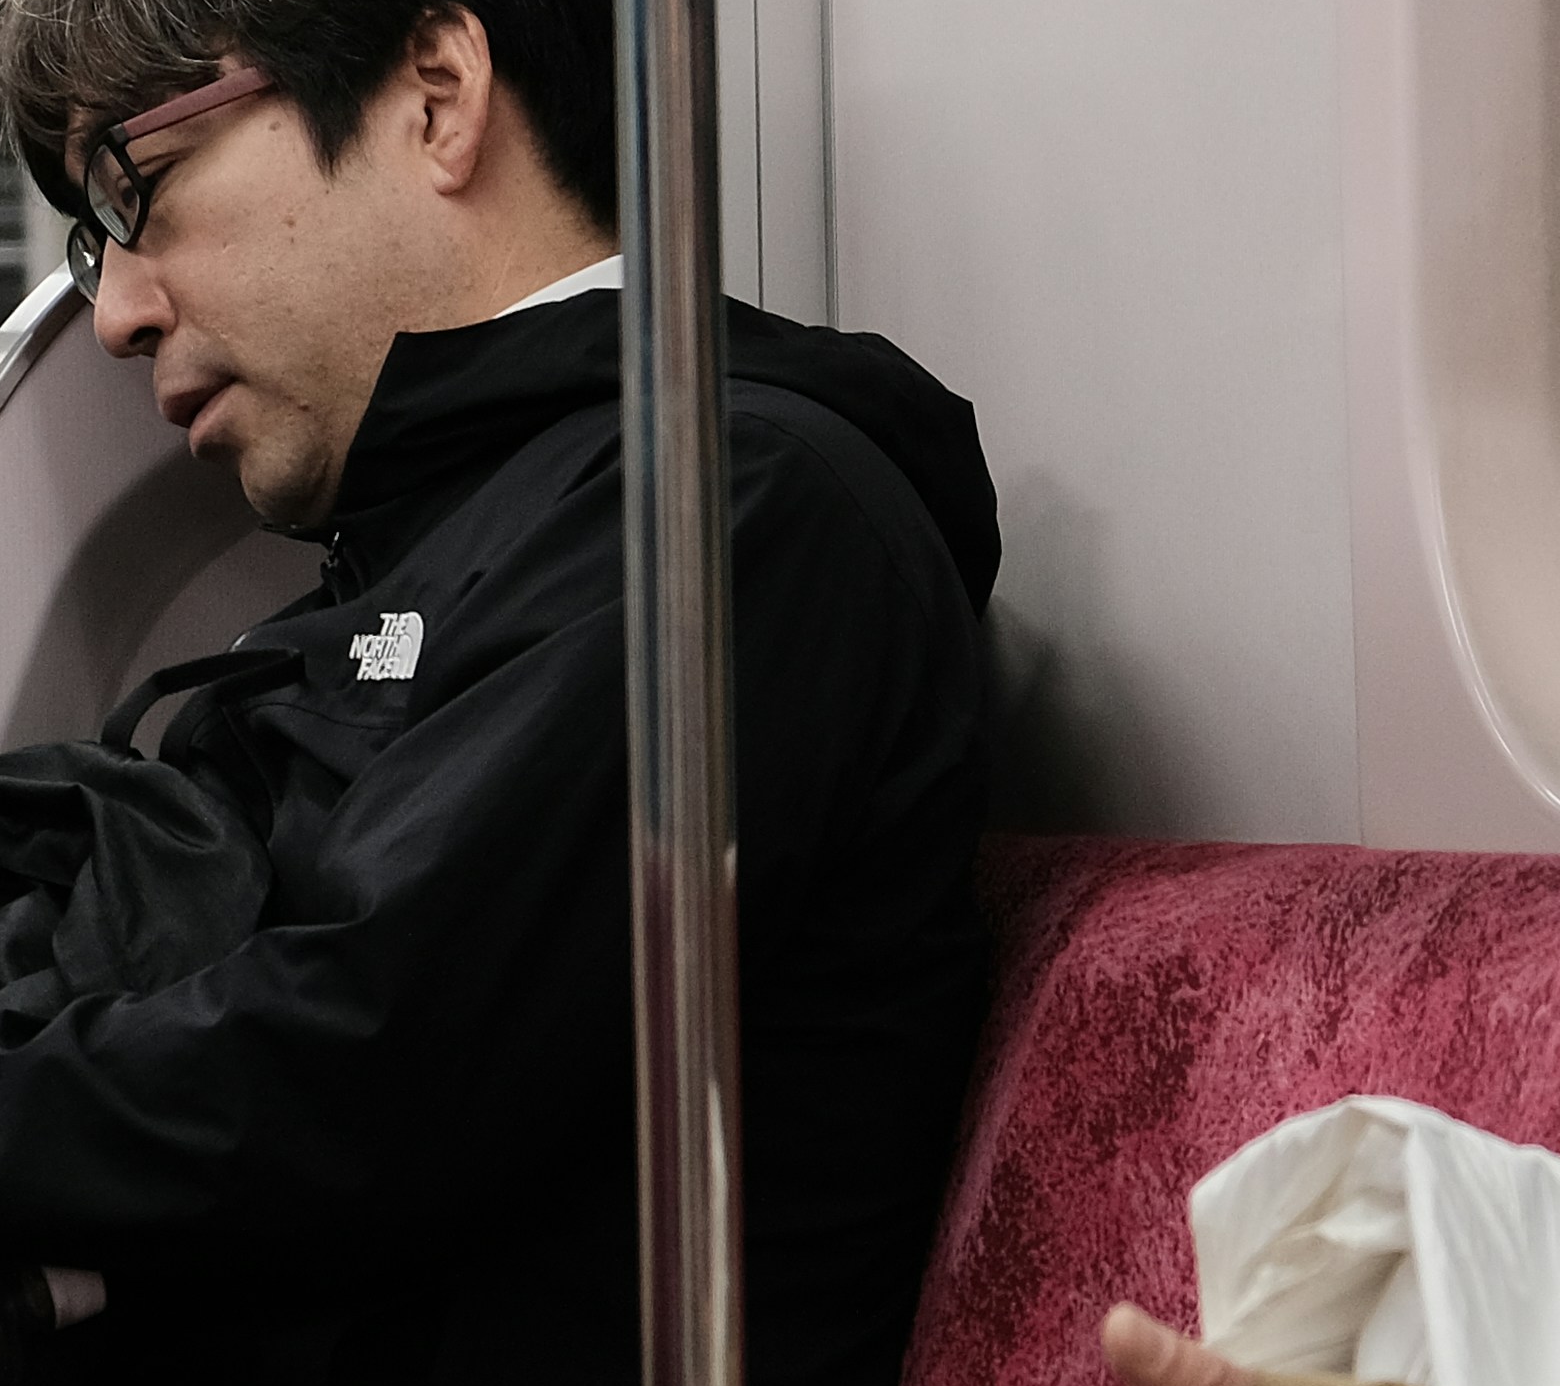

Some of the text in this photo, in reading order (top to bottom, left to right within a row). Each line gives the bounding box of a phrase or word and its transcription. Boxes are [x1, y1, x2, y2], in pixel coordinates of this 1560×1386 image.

[380, 612, 412, 635] THE
[349, 634, 403, 659] NORTH
[357, 658, 396, 681] FACE
